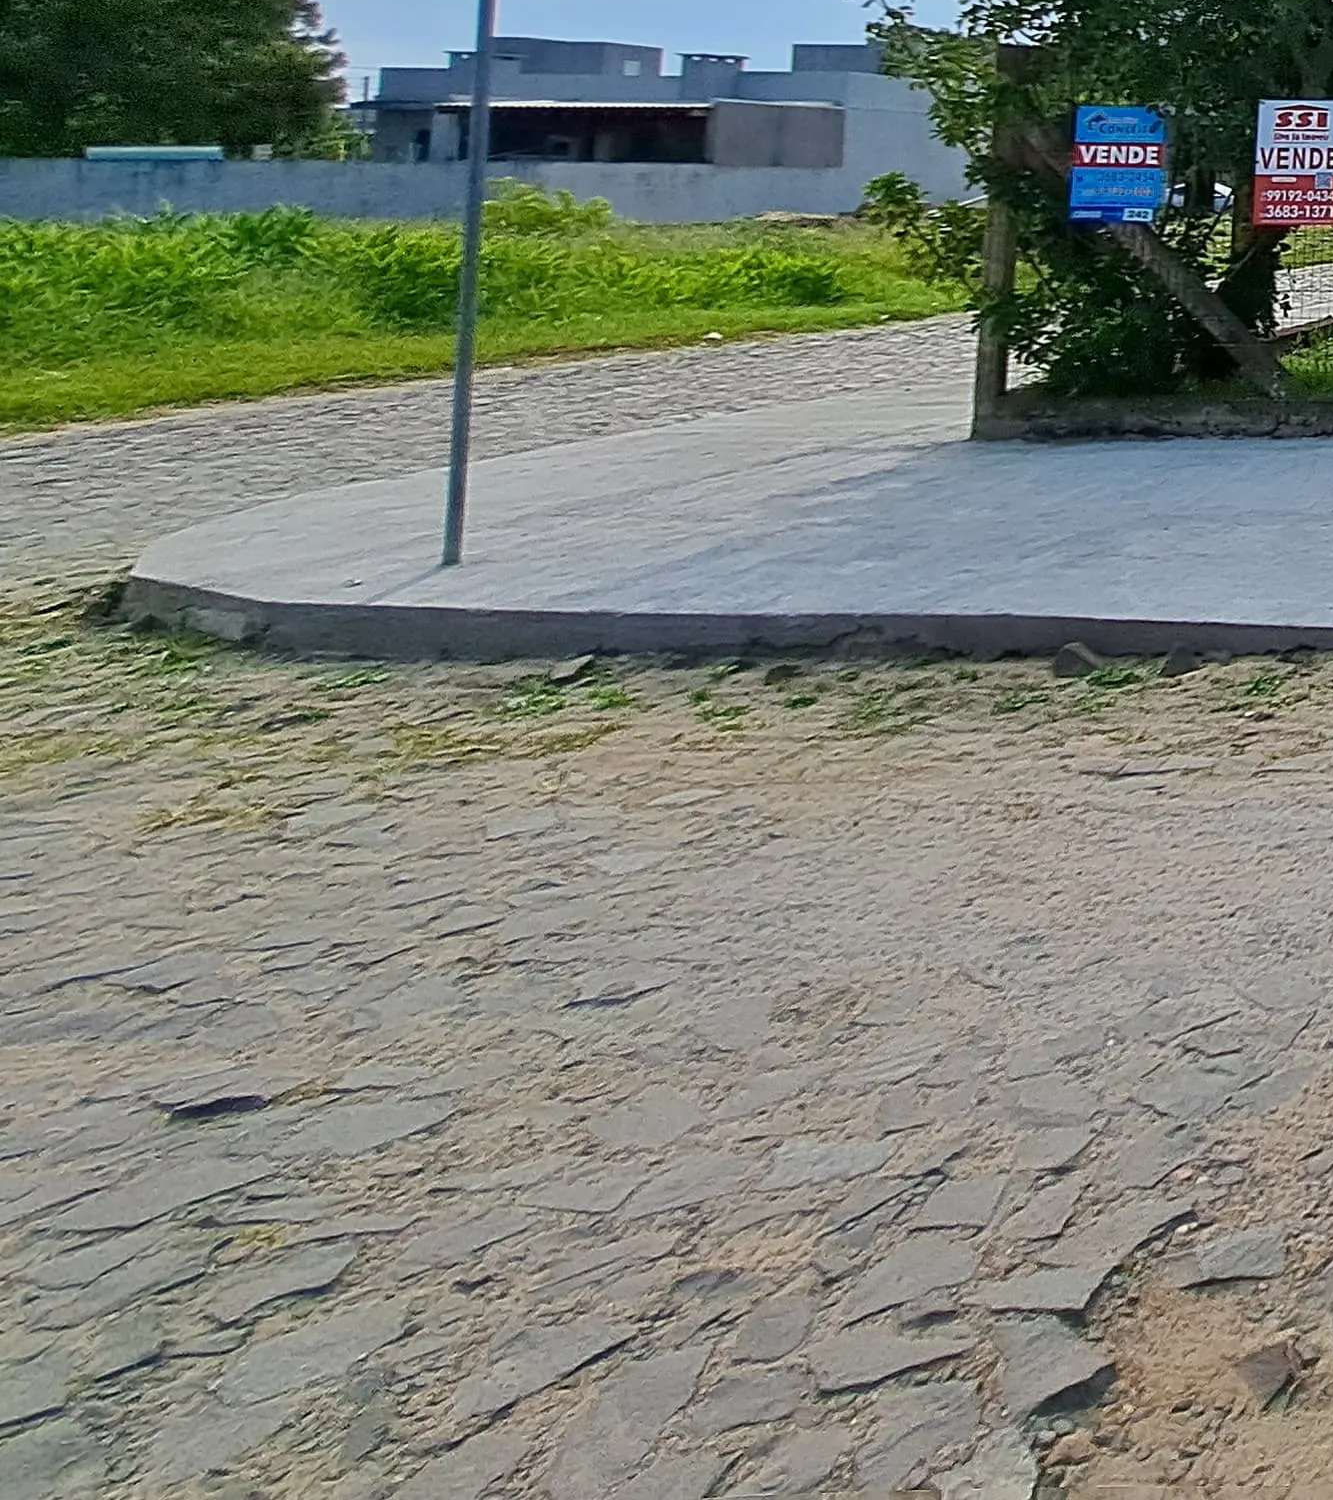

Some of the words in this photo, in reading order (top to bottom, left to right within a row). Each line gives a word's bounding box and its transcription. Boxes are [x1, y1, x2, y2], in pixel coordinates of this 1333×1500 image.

[1275, 112, 1328, 127] SSI
[1079, 145, 1160, 165] VENDE
[1127, 210, 1149, 219] 242
